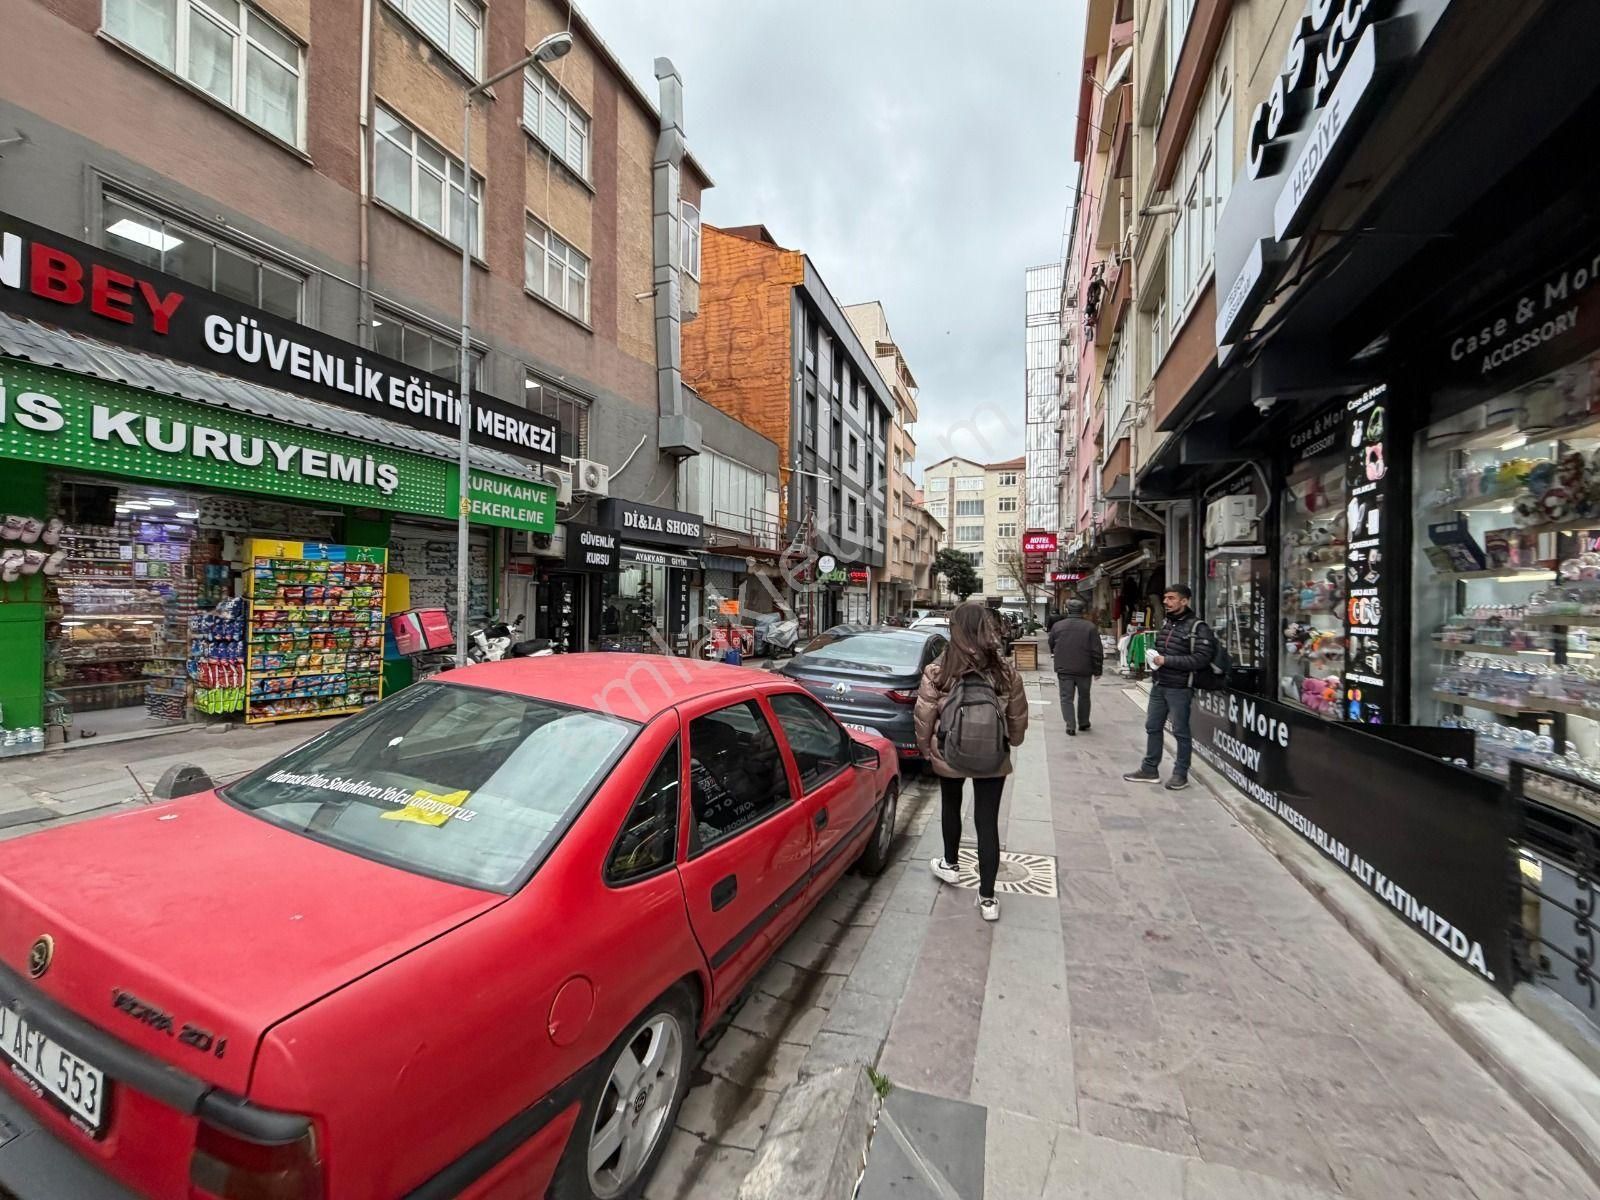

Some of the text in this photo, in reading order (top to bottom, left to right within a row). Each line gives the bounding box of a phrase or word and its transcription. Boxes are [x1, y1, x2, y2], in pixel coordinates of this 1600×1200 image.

[1451, 317, 1507, 361] Case
[1515, 296, 1536, 325] &
[1481, 305, 1579, 373] ACCESSORY
[204, 315, 384, 402] GÜVENLİK
[477, 406, 556, 455] MERKEZİ
[92, 405, 399, 496] KURUYEMİŞ
[1301, 433, 1336, 460] ACCESSORY
[580, 531, 615, 549] GÜVENLİK
[623, 509, 700, 538] Dİ&LA SHOES
[586, 552, 609, 566] KURSU
[635, 553, 666, 564] AYAKKABI
[1228, 694, 1239, 724] &
[1242, 698, 1289, 748] More
[1213, 727, 1261, 773] ACCESSORY
[377, 786, 412, 807] Yolcu
[407, 794, 478, 822] almıyoruz
[1247, 778, 1278, 812] MODELİ
[1277, 800, 1350, 868] AKSESUARLARI
[1350, 854, 1375, 886] ALT
[1375, 871, 1496, 982] KATIMIZDA.
[12, 1016, 46, 1079] AFK
[57, 1050, 98, 1115] 553
